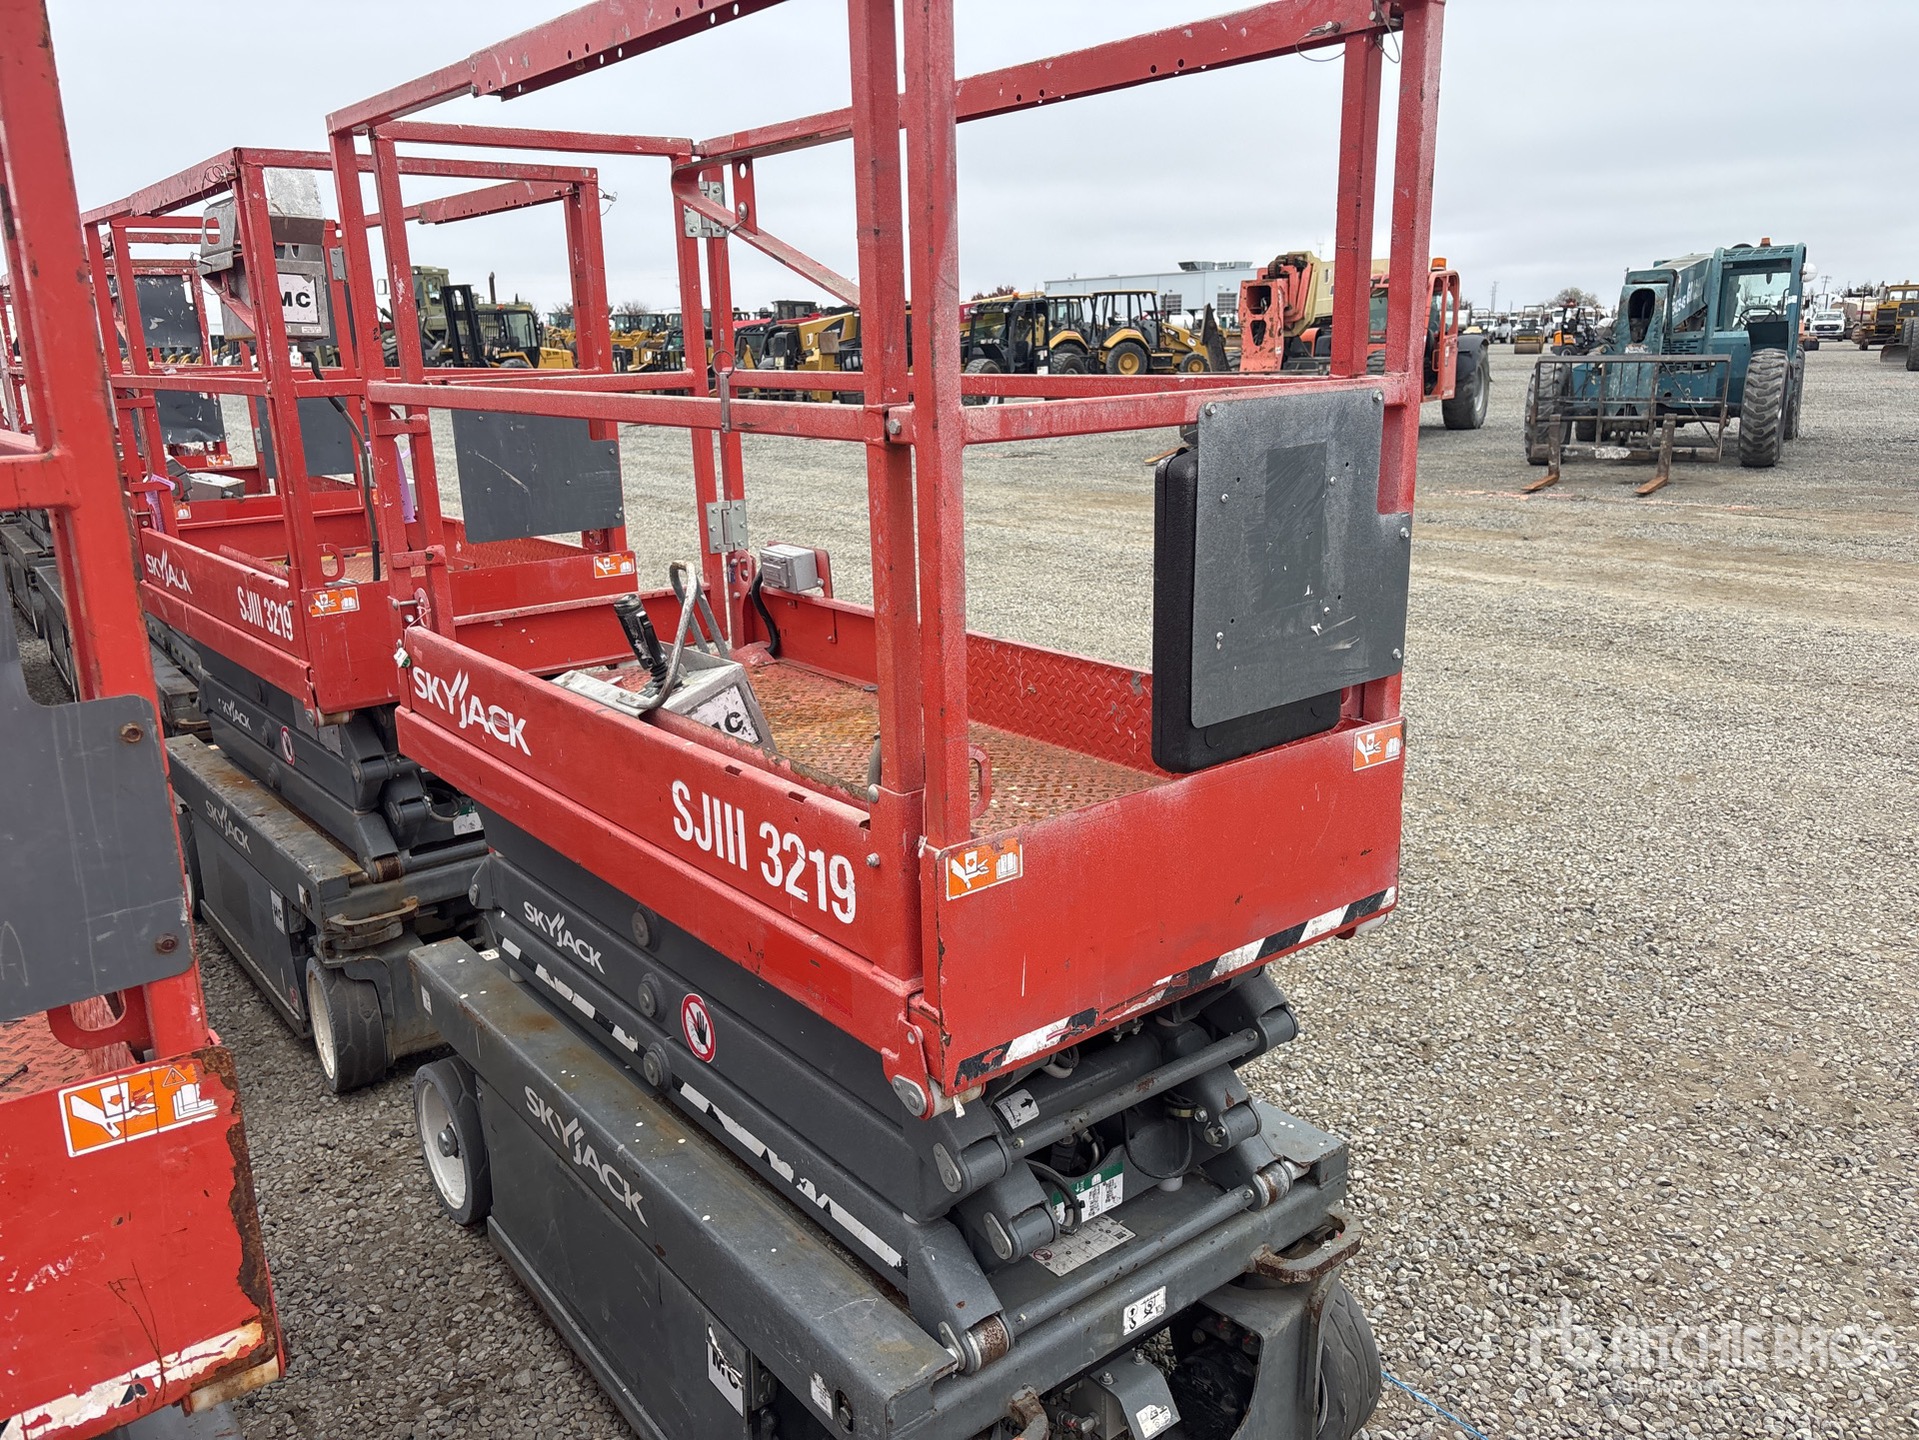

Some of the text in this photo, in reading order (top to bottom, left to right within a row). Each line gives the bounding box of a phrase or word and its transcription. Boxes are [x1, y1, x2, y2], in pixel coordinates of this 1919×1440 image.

[237, 585, 294, 641] SJIII 3219
[412, 666, 532, 757] SKYJACK
[205, 799, 252, 855] SKYJACK
[672, 779, 856, 924] SJIII 3219
[523, 900, 606, 975] SKYJACK
[524, 1085, 650, 1228] SKYJACK
